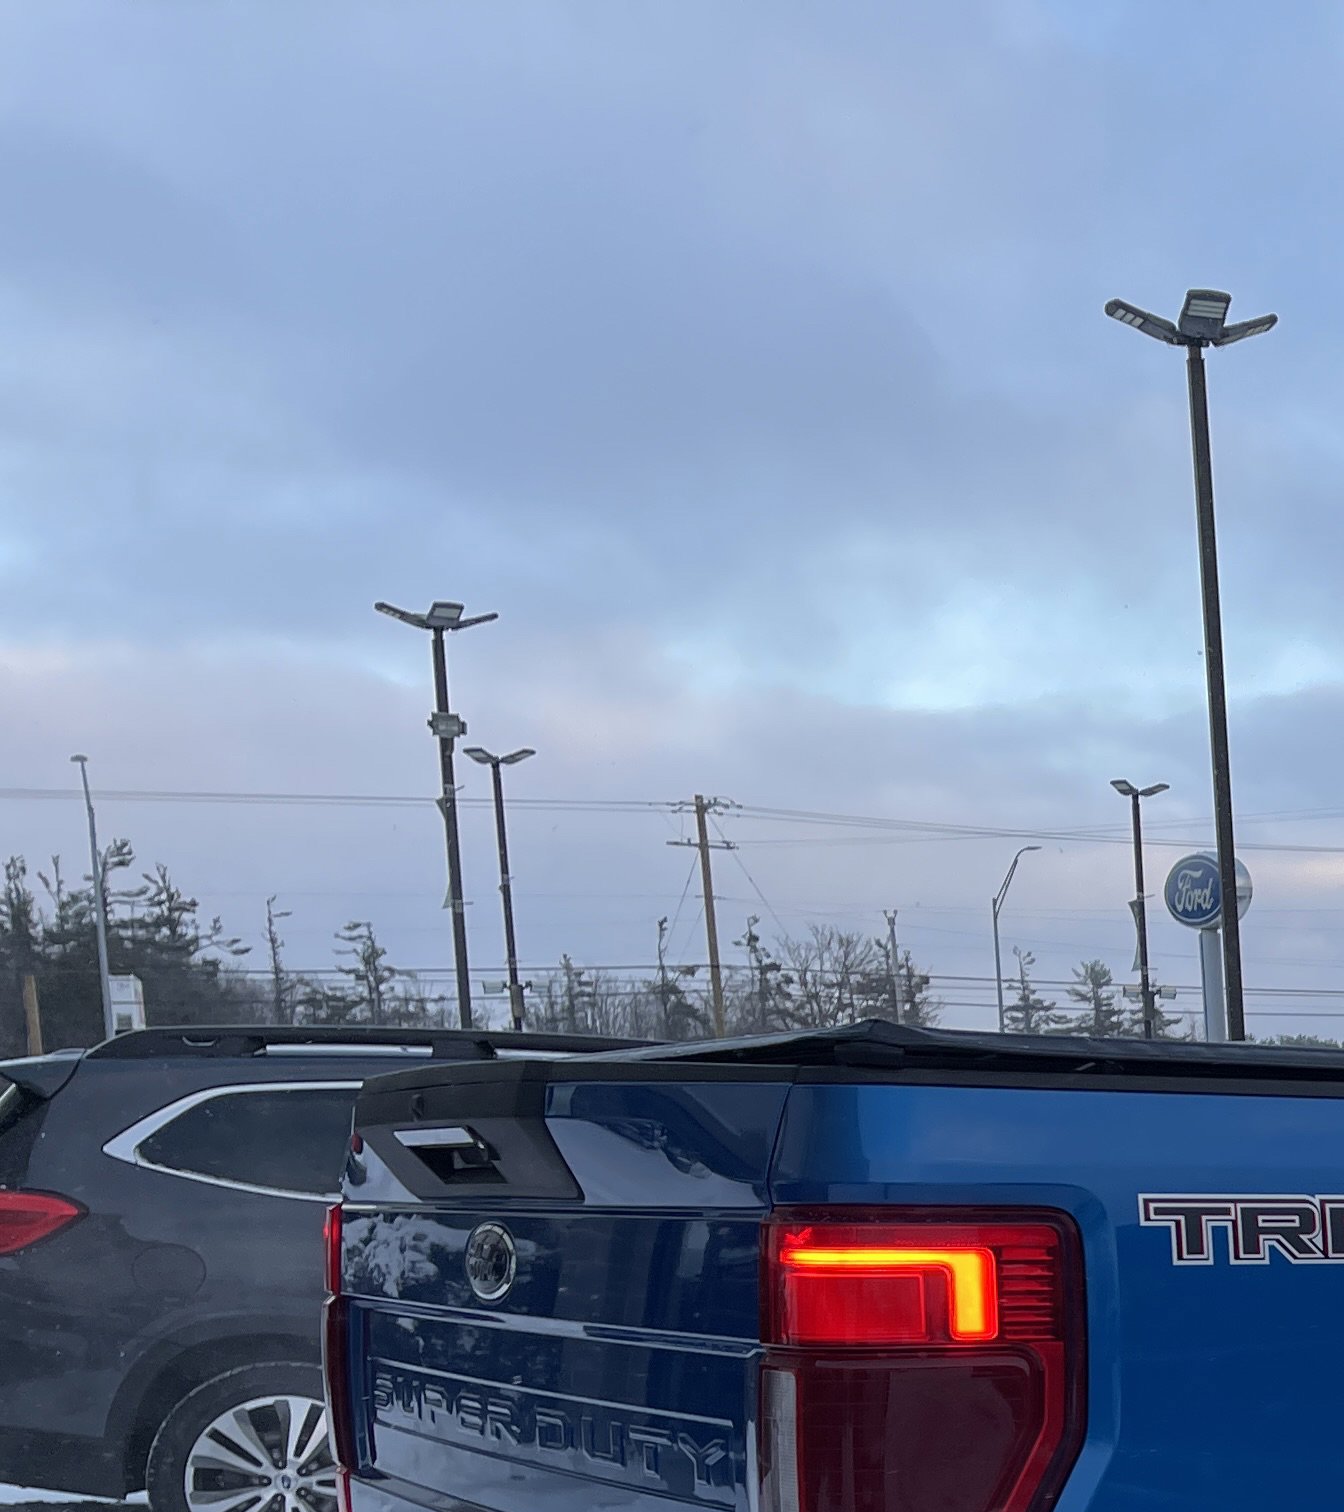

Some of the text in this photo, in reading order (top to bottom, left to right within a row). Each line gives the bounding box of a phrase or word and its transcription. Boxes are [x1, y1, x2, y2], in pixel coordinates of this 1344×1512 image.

[1175, 868, 1215, 913] Ford
[373, 1372, 727, 1487] SUPER DUTY
